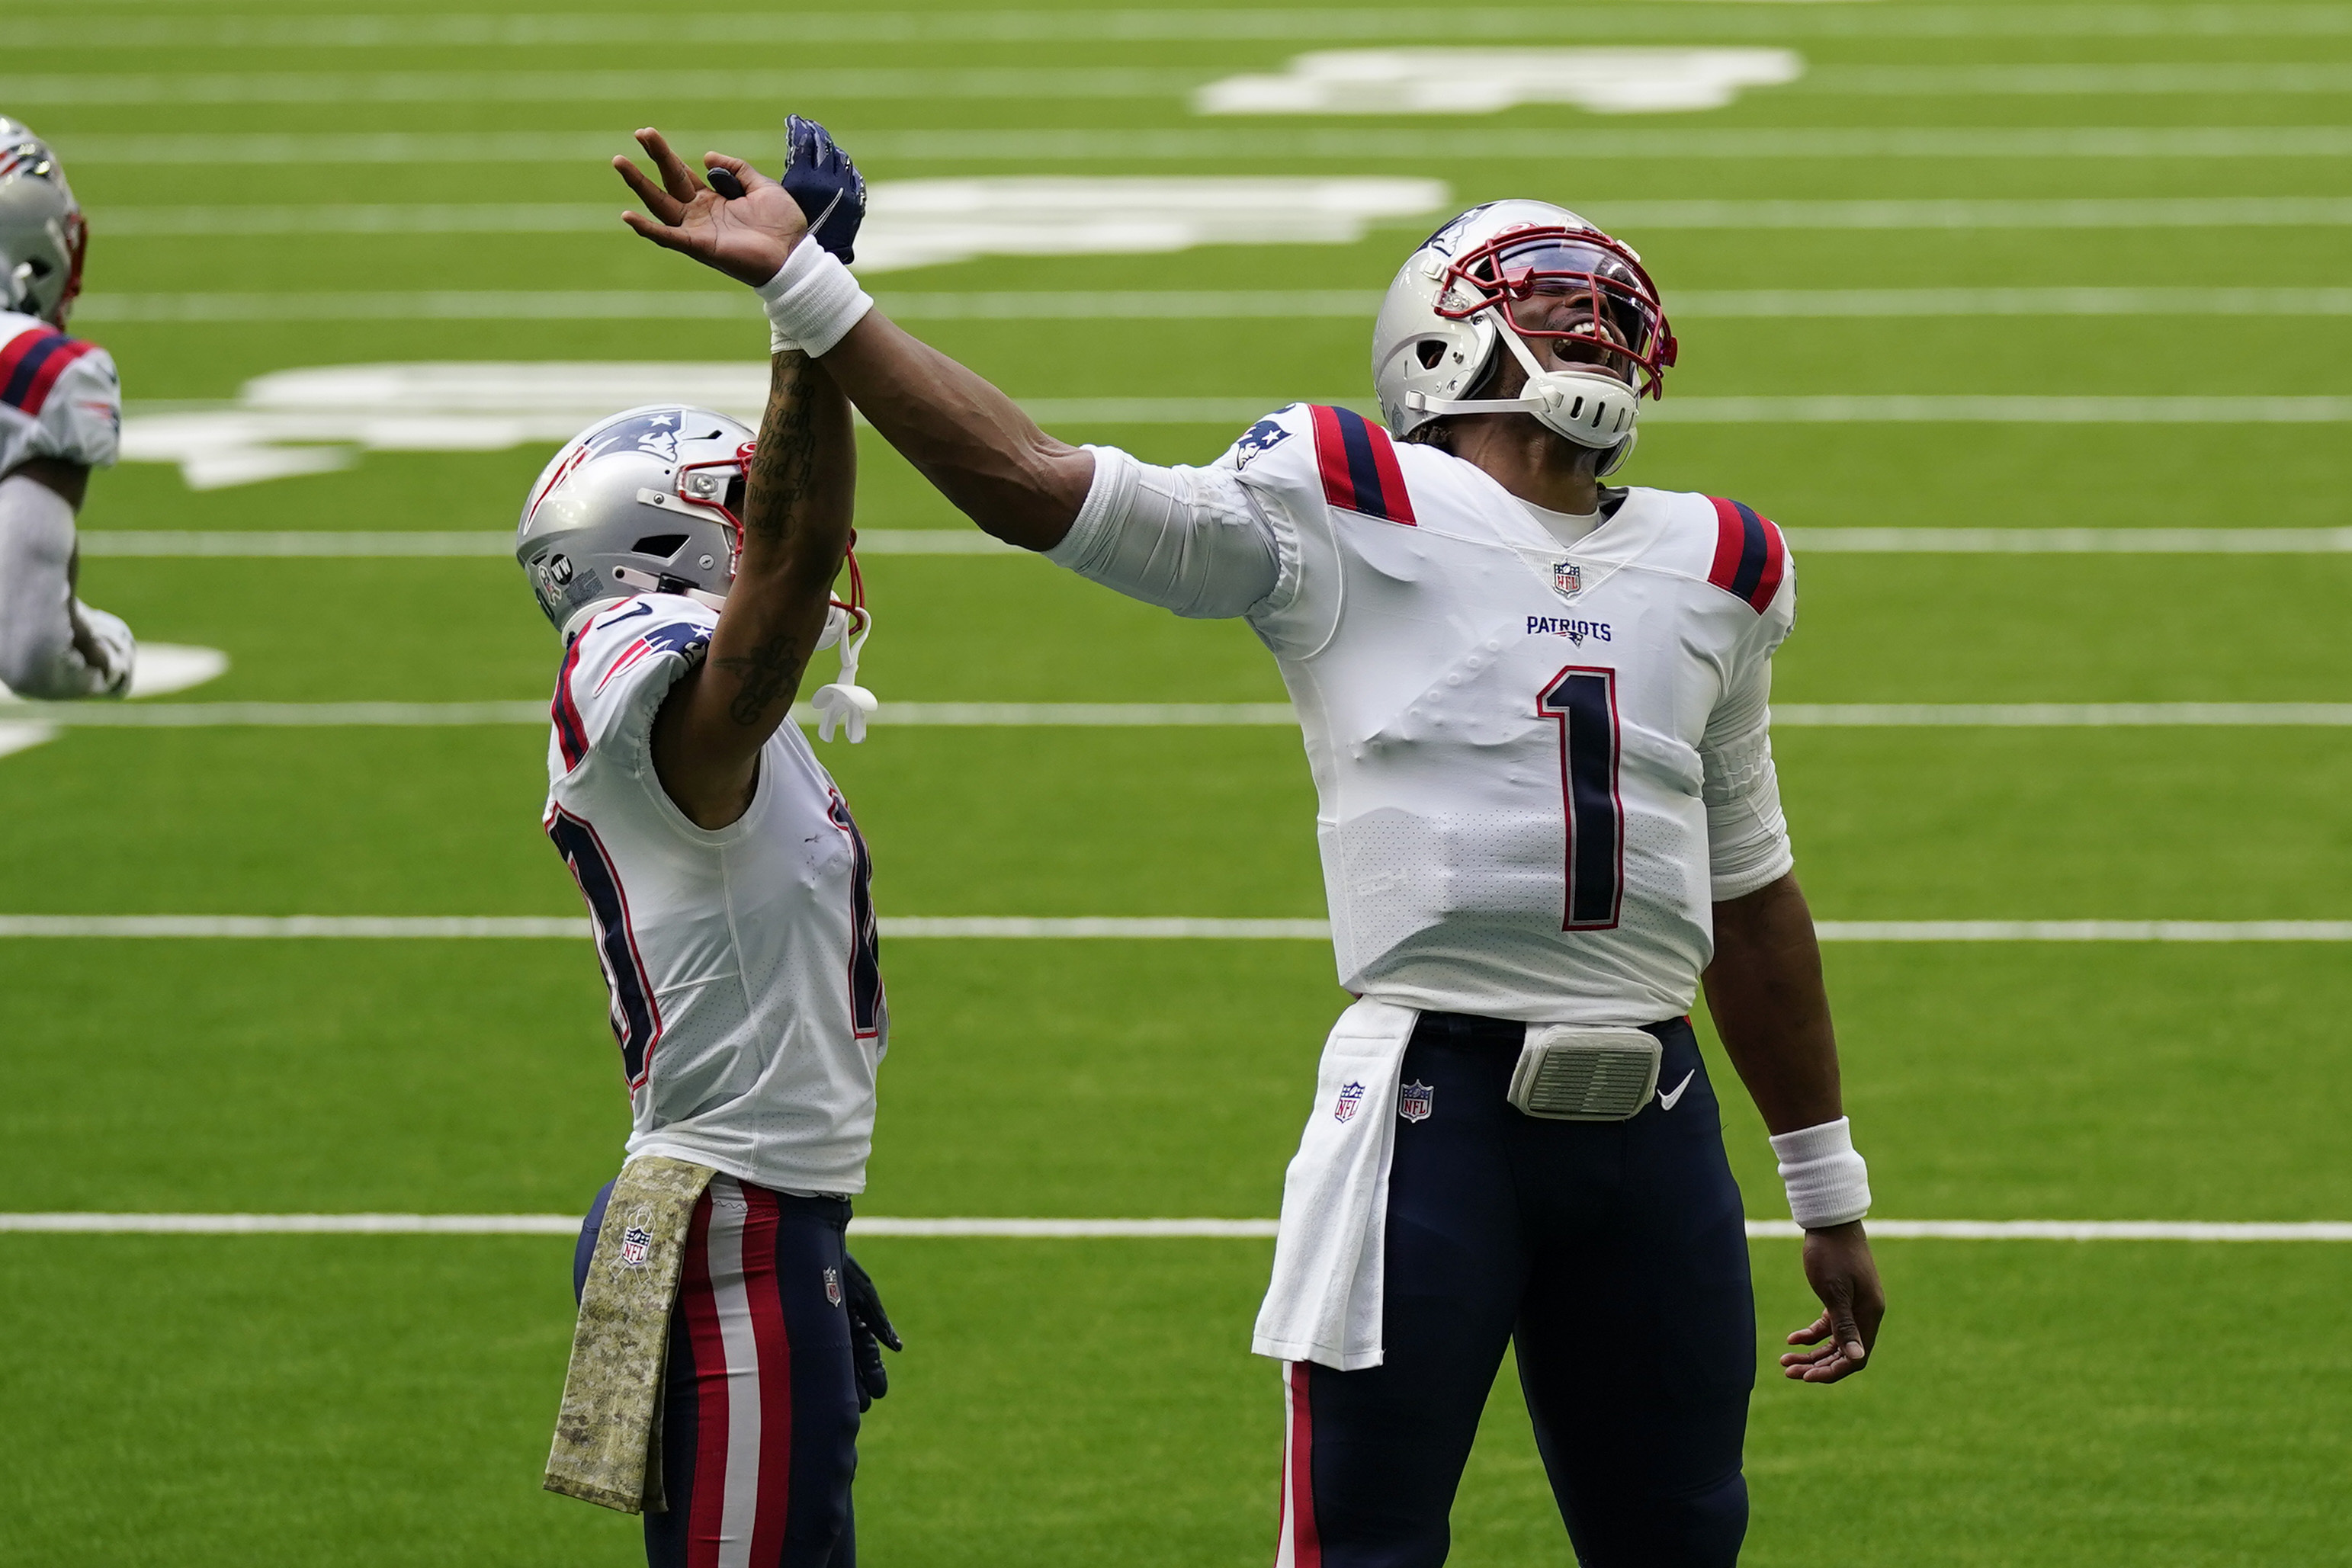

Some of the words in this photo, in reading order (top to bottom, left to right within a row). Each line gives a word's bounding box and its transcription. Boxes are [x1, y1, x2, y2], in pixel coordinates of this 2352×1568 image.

[551, 556, 571, 581] WW
[1557, 575, 1578, 590] NFL
[1526, 615, 1611, 642] PATRIOTS
[1536, 665, 1625, 932] 1
[1336, 1099, 1357, 1119] NFL
[1404, 1098, 1426, 1115] NFL
[622, 1242, 643, 1262] NFL
